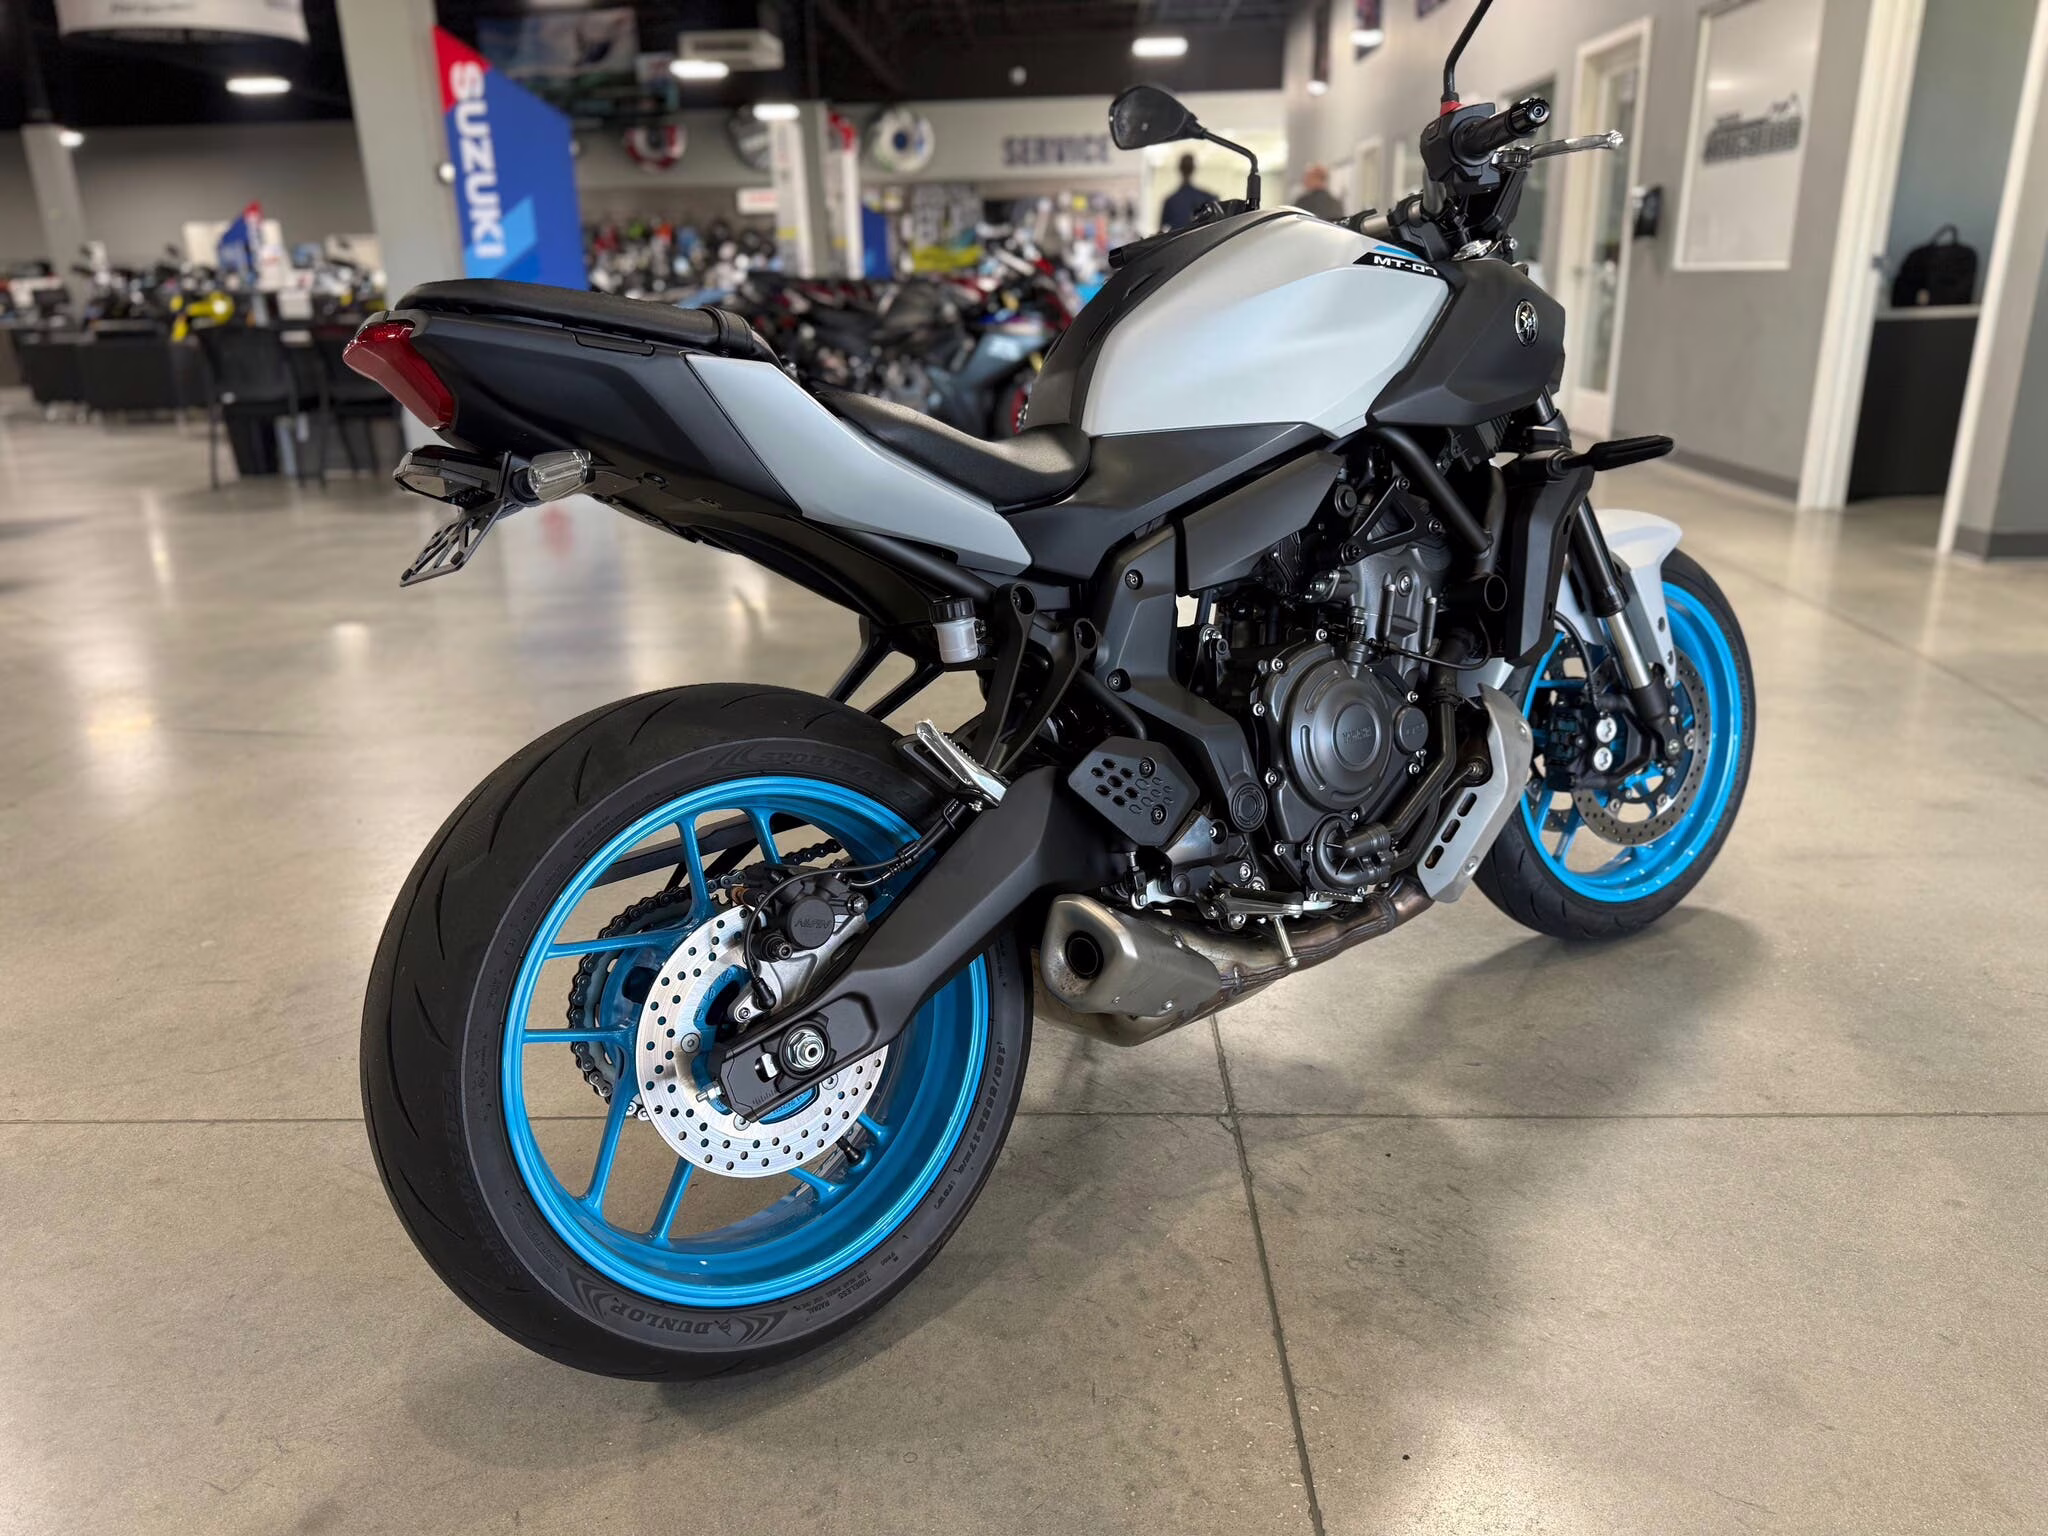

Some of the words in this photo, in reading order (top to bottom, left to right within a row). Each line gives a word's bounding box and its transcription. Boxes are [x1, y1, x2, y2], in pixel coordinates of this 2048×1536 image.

[450, 61, 506, 258] SUZUKI
[1003, 137, 1109, 165] SERVICE
[1373, 255, 1438, 276] MT-07
[609, 1298, 713, 1336] DUNLOP
